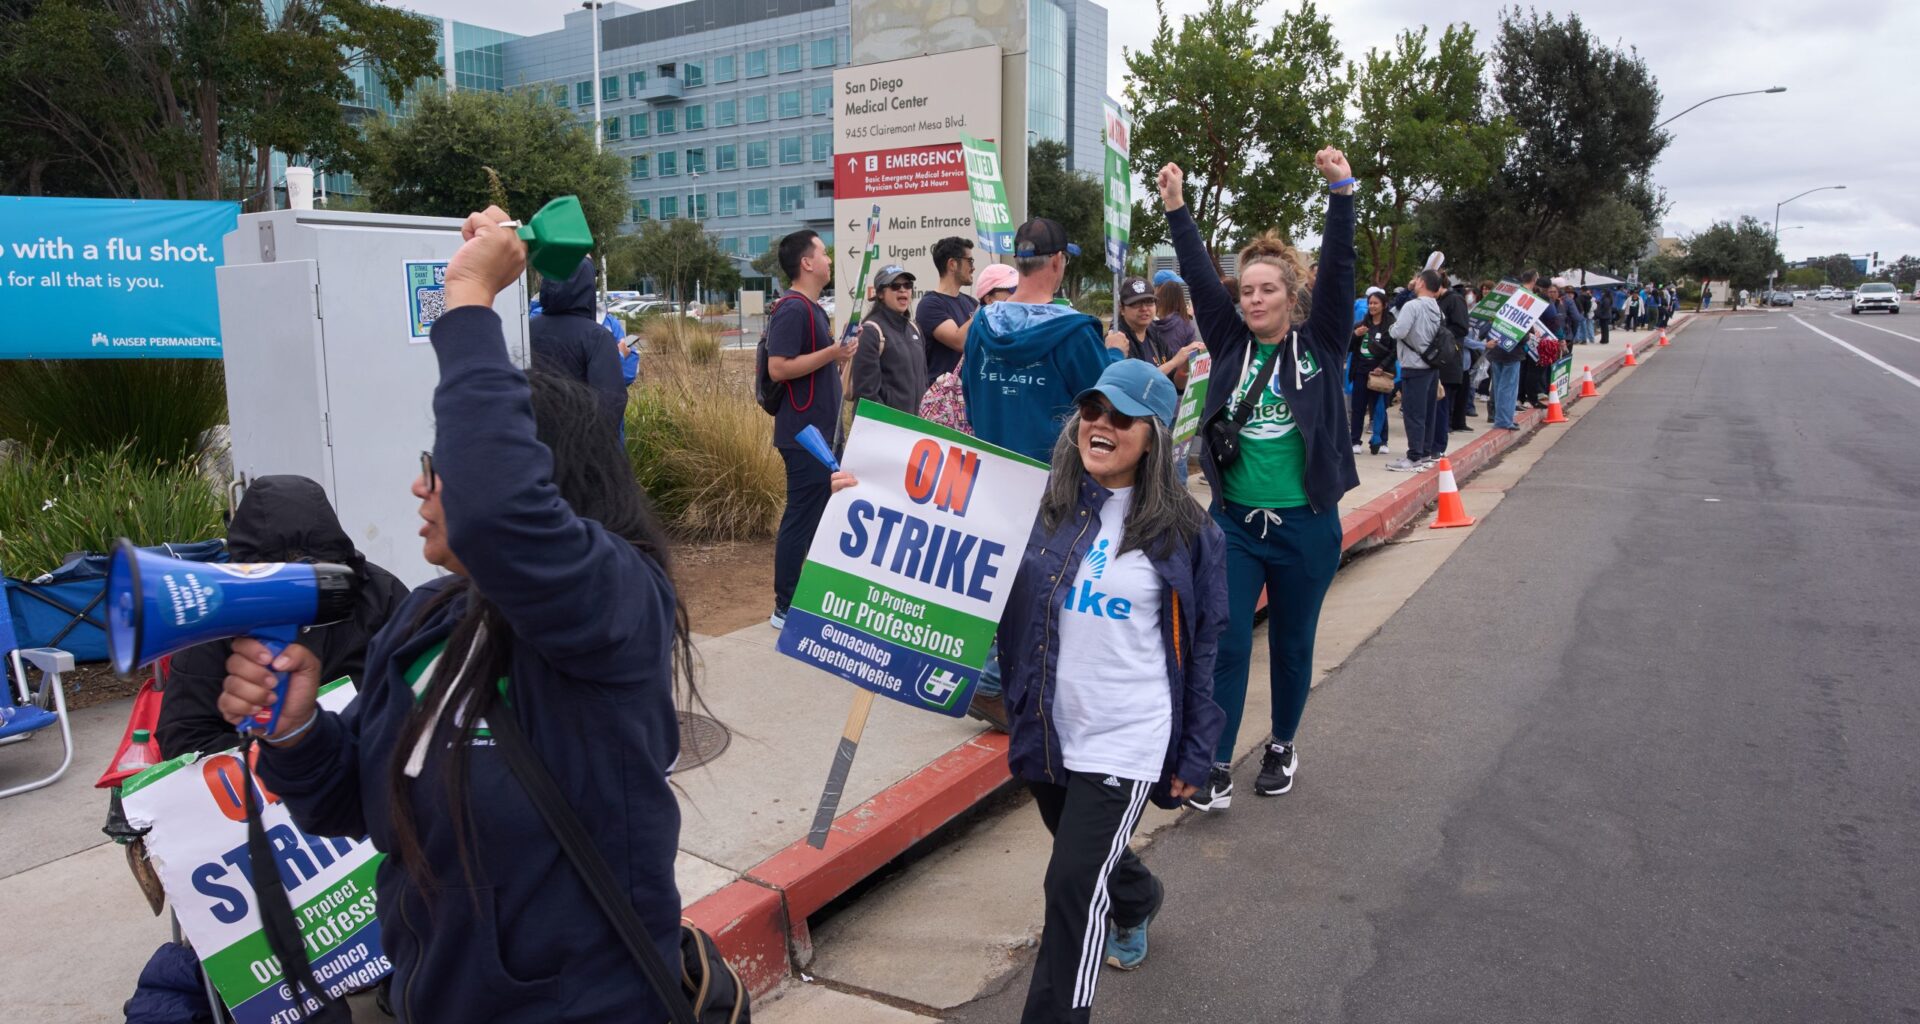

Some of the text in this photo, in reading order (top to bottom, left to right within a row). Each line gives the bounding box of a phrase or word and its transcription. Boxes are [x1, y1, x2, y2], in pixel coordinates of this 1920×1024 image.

[845, 76, 904, 95] San Diego
[845, 95, 929, 116] Medical Center
[845, 114, 967, 139] 9455 Clairemont Mesa Blvd.
[886, 149, 964, 169] EMERGENCY
[865, 169, 964, 184] Basic Emergency Medical Service
[865, 179, 949, 193] Physician On Duty 24 Hours
[888, 214, 971, 230] Main Entrance
[12, 236, 74, 260] with
[82, 244, 99, 260] a
[106, 237, 142, 261] flu
[150, 238, 215, 262] shot.
[888, 244, 927, 261] Urgent
[8, 270, 165, 292] for all that is you.
[1517, 292, 1536, 311] ON
[1499, 303, 1534, 329] STRIKE
[112, 337, 147, 347] KAISER
[980, 372, 1046, 386] PELAGIC
[1254, 402, 1290, 420] ieg
[904, 438, 981, 518] ON
[839, 498, 1006, 603] STRIKE
[163, 574, 186, 626] SURVIVING
[179, 585, 197, 609] NOT
[185, 573, 209, 617] THRIVING
[866, 585, 926, 620] To Protect
[1064, 579, 1132, 620] ike
[821, 591, 965, 658] Our Professions
[821, 623, 892, 667] @unacuhcp
[797, 636, 903, 692] #TogetherWeRise
[191, 816, 372, 924] STRI
[303, 879, 359, 923] Protect
[250, 886, 379, 984] Ou rofessi
